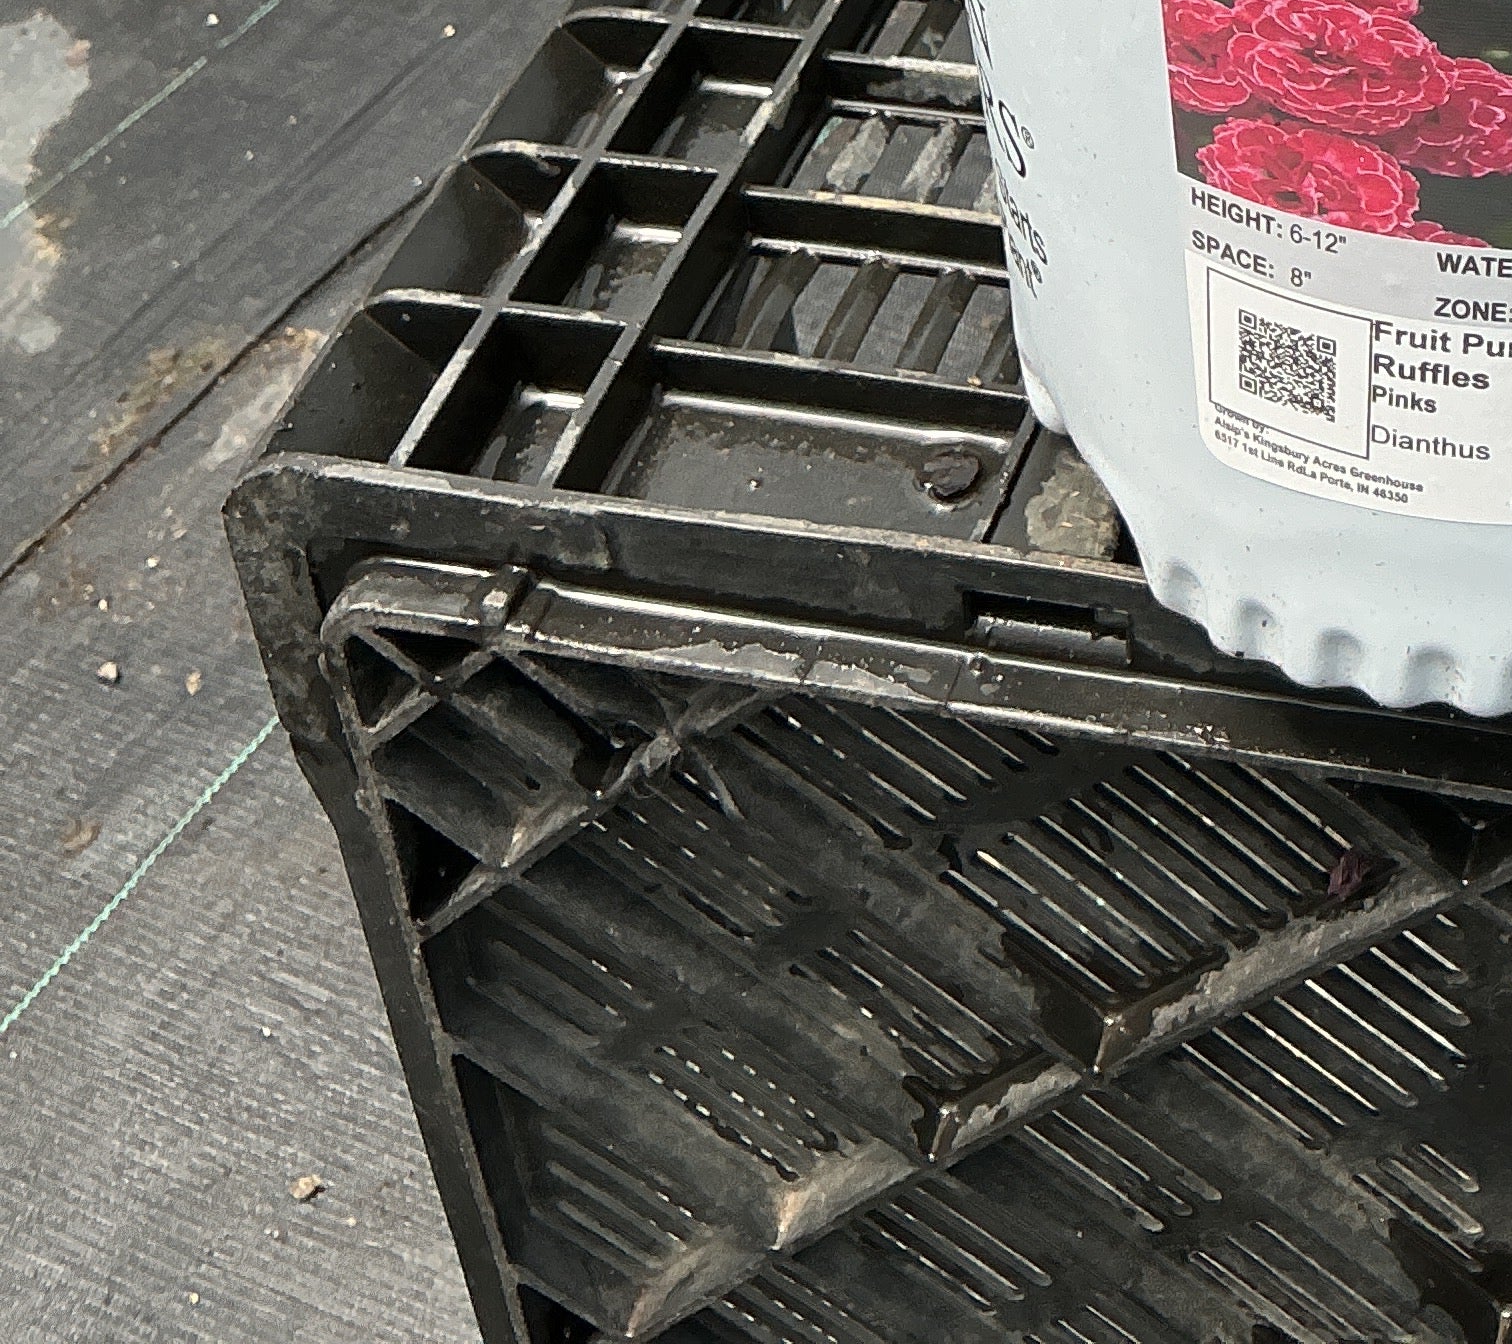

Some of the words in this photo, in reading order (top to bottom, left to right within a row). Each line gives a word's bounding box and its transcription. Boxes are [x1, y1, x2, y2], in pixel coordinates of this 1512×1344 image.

[1190, 186, 1284, 241] HEIGHT:
[1289, 223, 1348, 255] 6-12"
[1190, 228, 1276, 280] SPACE:
[1289, 268, 1313, 289] 8"
[1374, 319, 1451, 355] Fruit
[1373, 353, 1491, 391] Ruffles
[1371, 384, 1438, 414] Pinks
[1370, 423, 1492, 461] Dianthus
[1312, 455, 1347, 475] Acres
[1350, 465, 1424, 493] Greenhouse
